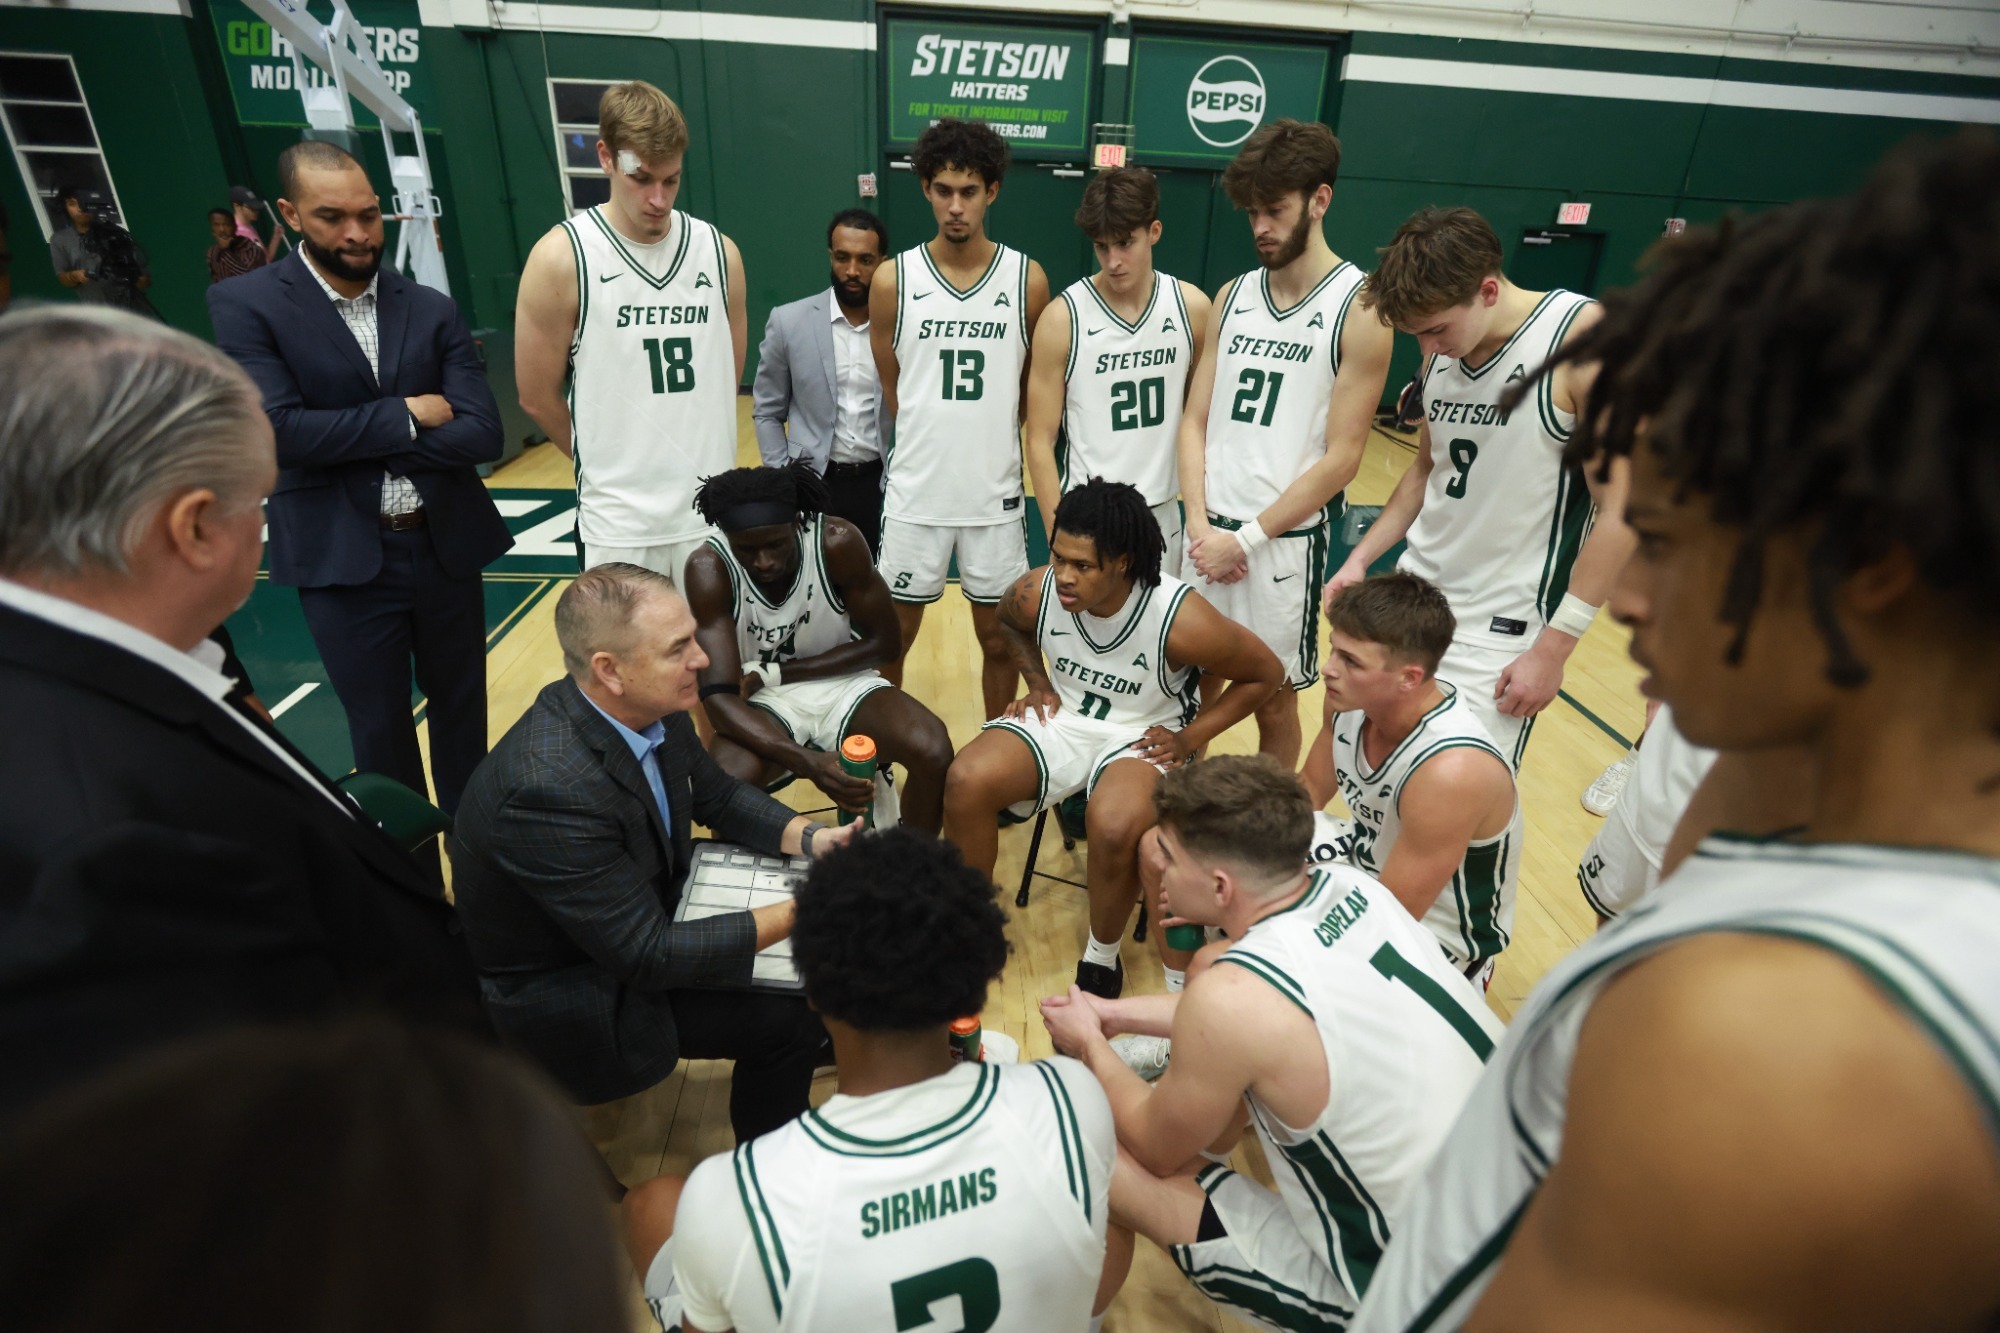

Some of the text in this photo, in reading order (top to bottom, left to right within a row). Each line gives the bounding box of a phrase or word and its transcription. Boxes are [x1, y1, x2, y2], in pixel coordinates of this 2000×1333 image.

[910, 34, 1071, 80] STETSON
[950, 81, 1029, 101] HATTERS
[1191, 90, 1262, 113] PEPSI
[909, 102, 1069, 123] FOR TICKET INFORMATION VISIT
[1101, 145, 1122, 165] EXIT
[1565, 205, 1586, 222] EXIT
[616, 305, 709, 328] STETSON
[918, 319, 1007, 340] STETSON
[1095, 347, 1177, 375] STETSON
[1227, 334, 1314, 363] STETSON
[643, 337, 695, 394] 18
[939, 349, 985, 401] 13
[1110, 376, 1165, 432] 20
[1230, 368, 1285, 427] 21
[1429, 399, 1512, 426] STETSON
[1445, 437, 1478, 500] 9
[747, 610, 811, 644] STETSN
[1055, 657, 1143, 696] STETSON
[1368, 940, 1498, 1067] 1
[861, 1167, 998, 1239] SIRMANS
